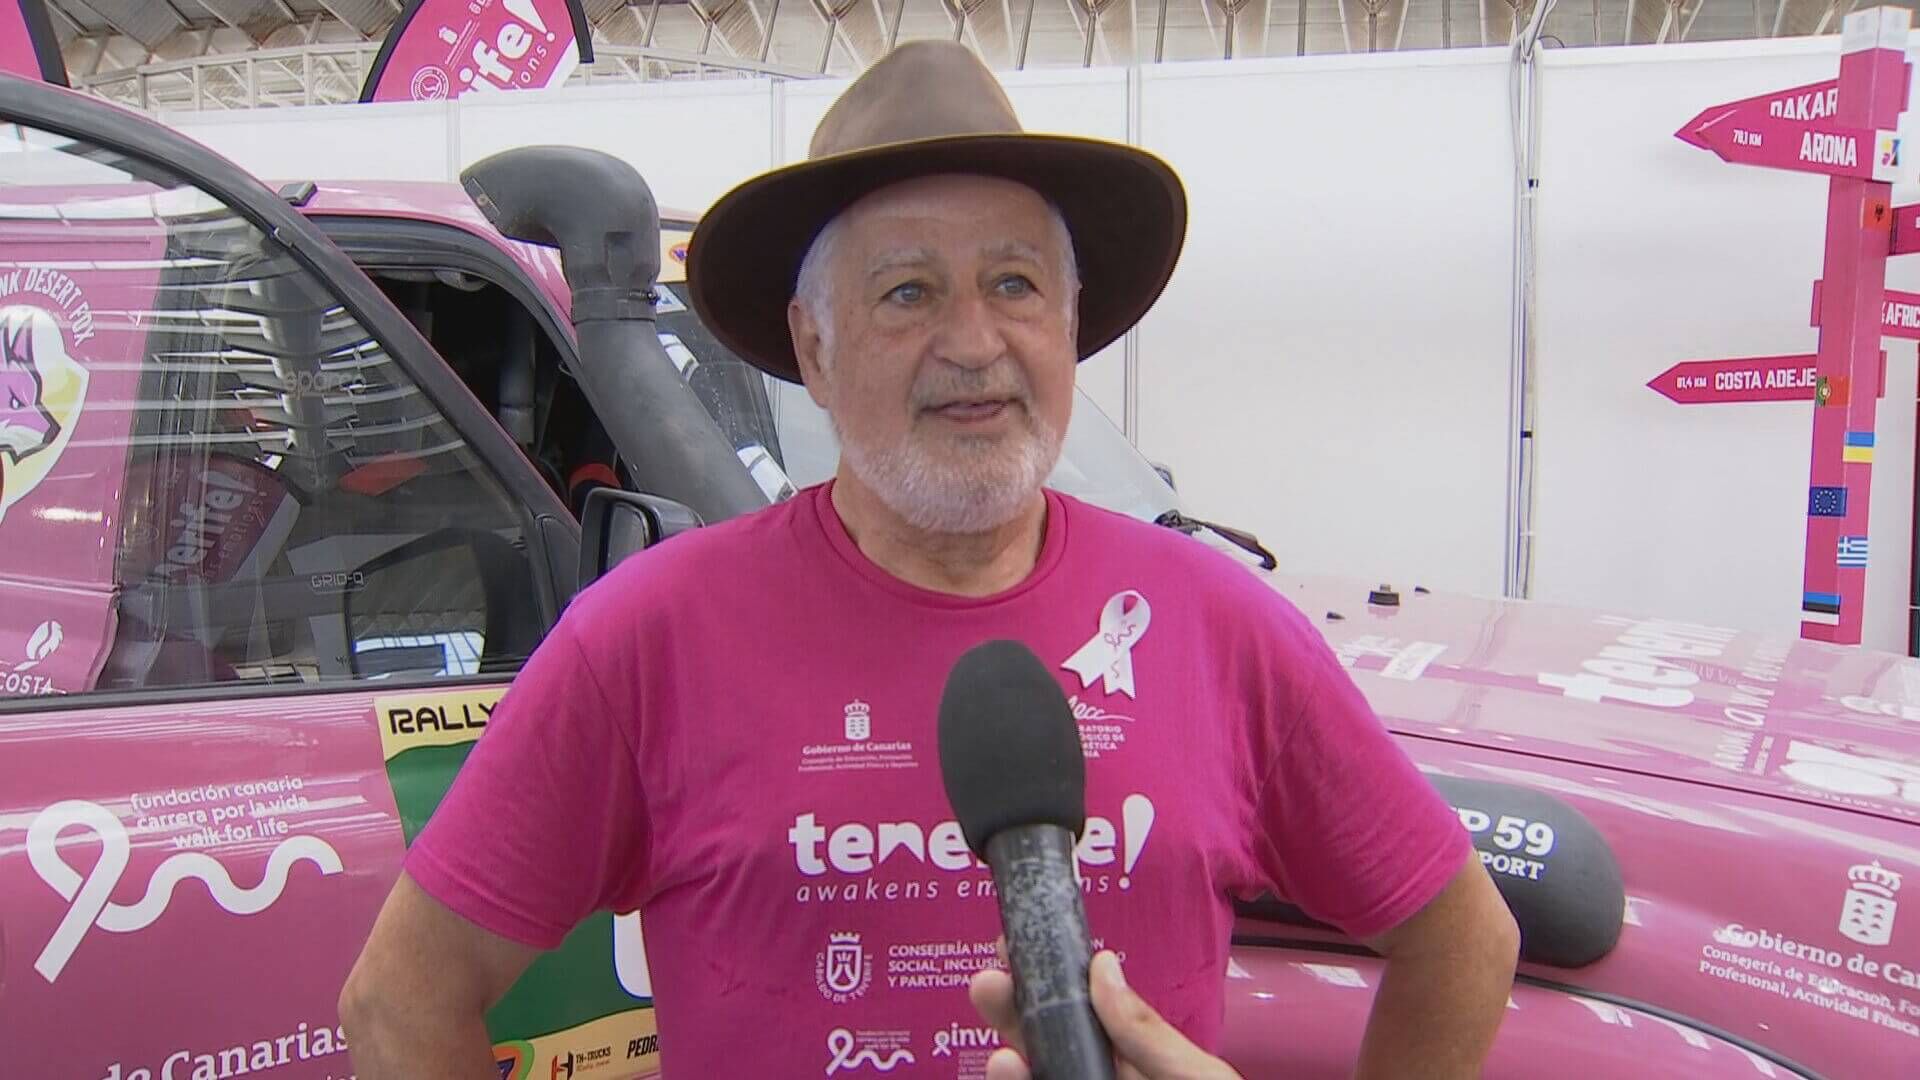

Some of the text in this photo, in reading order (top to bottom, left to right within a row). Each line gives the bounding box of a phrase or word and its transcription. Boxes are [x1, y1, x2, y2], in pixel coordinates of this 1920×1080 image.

[1800, 131, 1857, 167] ARONA
[23, 267, 82, 309] DESERT
[68, 301, 96, 347] FOX
[1714, 371, 1762, 391] COSTA
[1766, 367, 1817, 389] ADEJE
[802, 741, 912, 755] Gobierno de Canarias
[130, 776, 304, 810] fundación canaria
[137, 807, 208, 832] carrera
[211, 804, 245, 827] por
[270, 794, 309, 815] vida
[220, 825, 255, 842] for
[258, 818, 288, 837] life
[789, 794, 1155, 889] tenee!
[1492, 815, 1555, 857] 59
[796, 877, 939, 902] awakens
[888, 939, 971, 958] CONSEJERÍA
[1702, 944, 1782, 977] Consejería
[1784, 966, 1804, 982] de
[1724, 923, 1842, 968] Gobierno
[1846, 953, 1880, 977] de
[888, 960, 942, 974] SOCIAL,
[888, 974, 976, 988] Y PARTICIPA
[1699, 959, 1791, 998] Profesional,
[1793, 985, 1869, 1020] Actividad
[627, 1034, 660, 1060] PEDR
